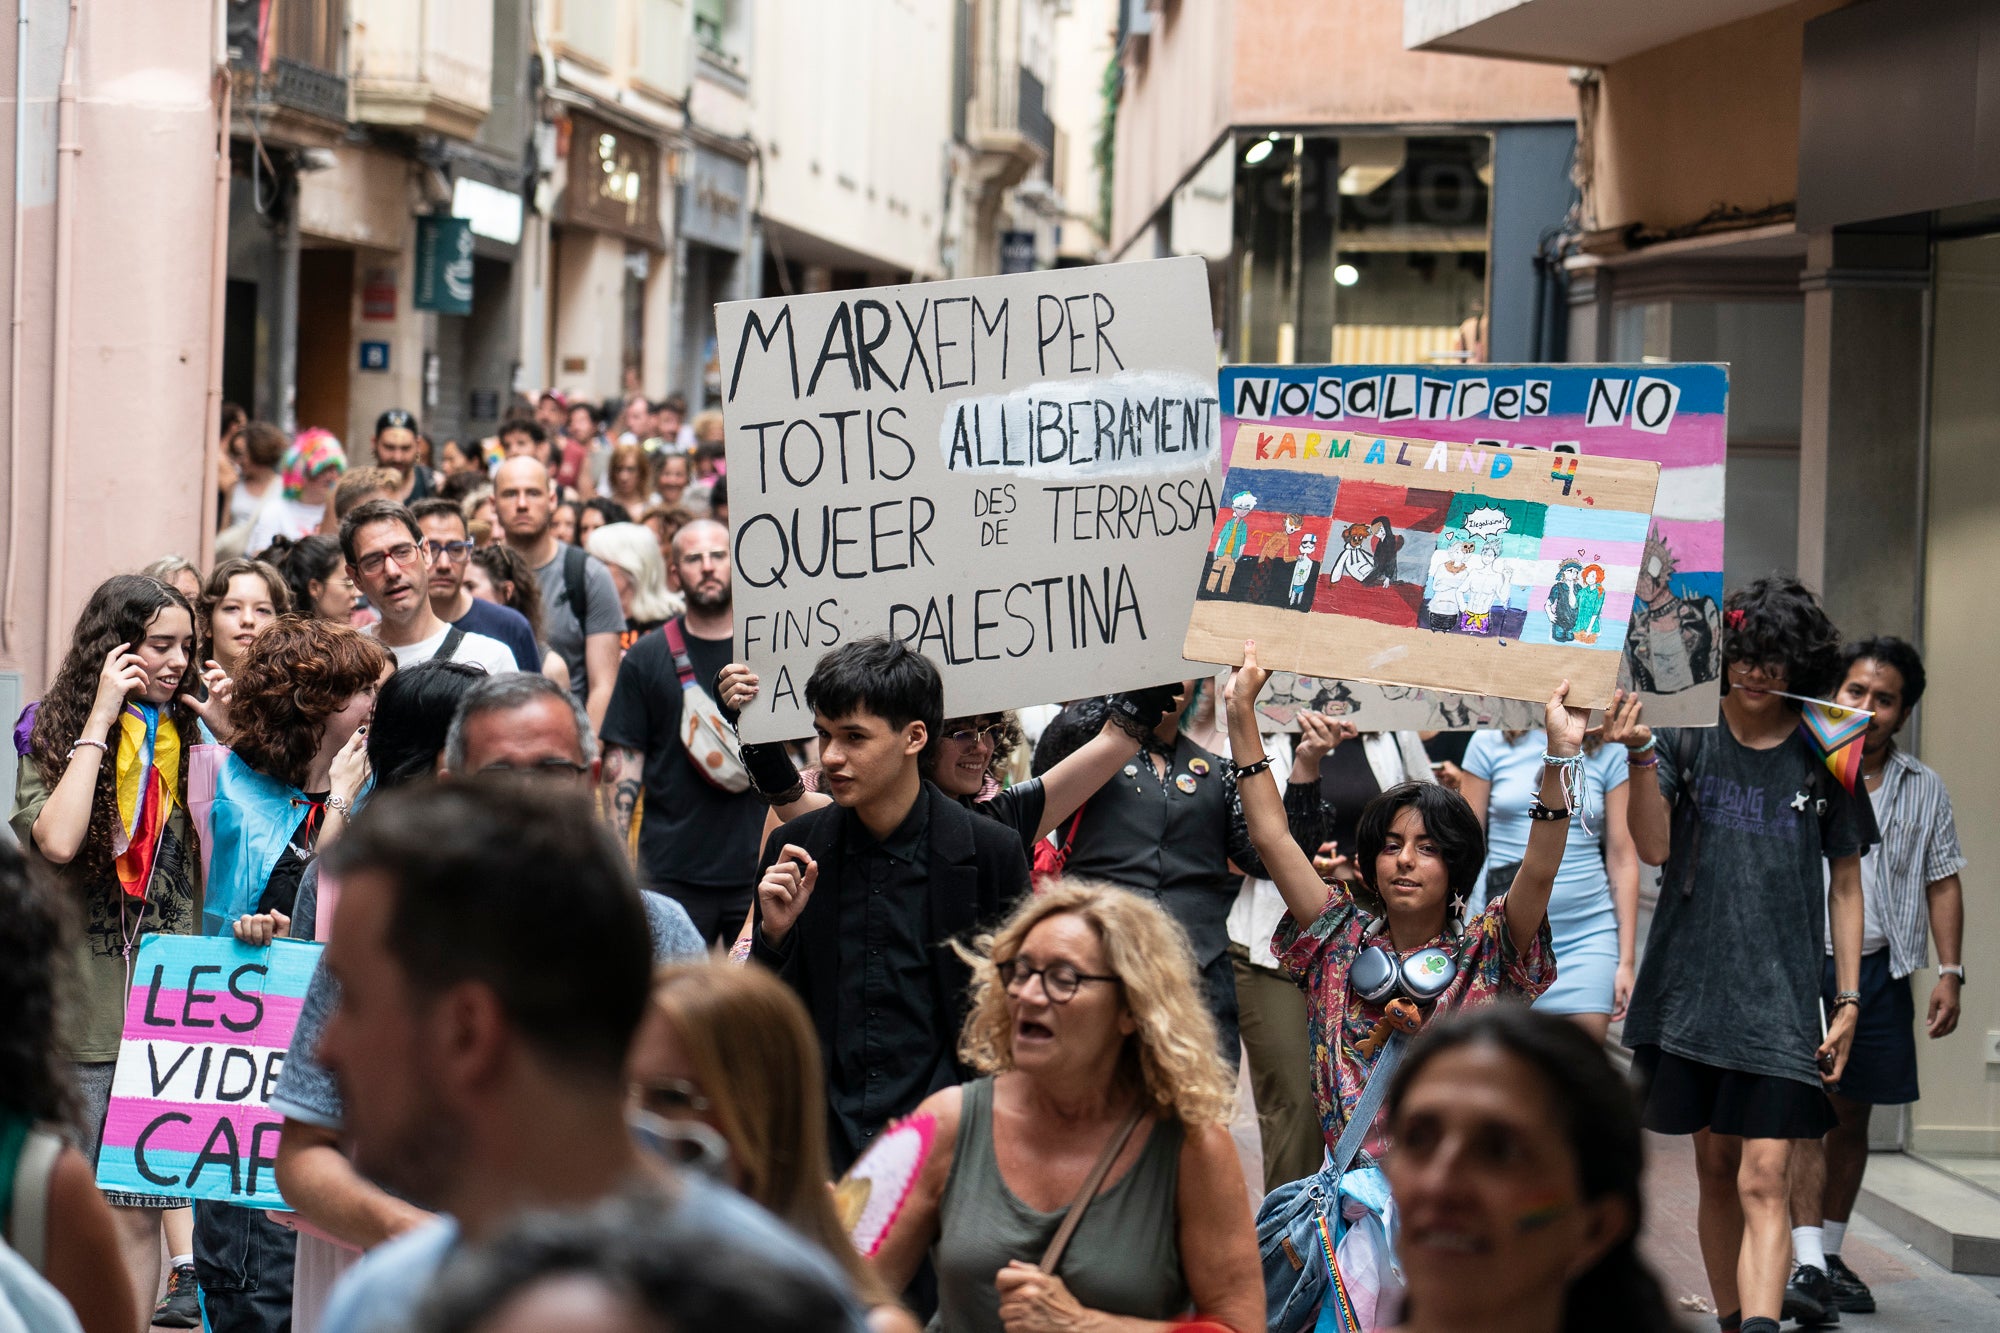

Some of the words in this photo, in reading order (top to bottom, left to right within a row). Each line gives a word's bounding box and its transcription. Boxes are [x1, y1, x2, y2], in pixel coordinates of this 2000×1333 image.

[728, 295, 1009, 402] MARXEM
[1037, 292, 1124, 376] PER
[1587, 377, 1670, 428] NO
[740, 406, 915, 494] TOTIS
[734, 496, 935, 589] QUEER
[974, 483, 1016, 518] DES
[1042, 478, 1217, 544] TERRASSA
[980, 519, 1010, 547] DE
[744, 598, 841, 662] FINS
[889, 563, 1147, 666] PALESTINA
[770, 664, 800, 714] A
[143, 963, 269, 1032] LES
